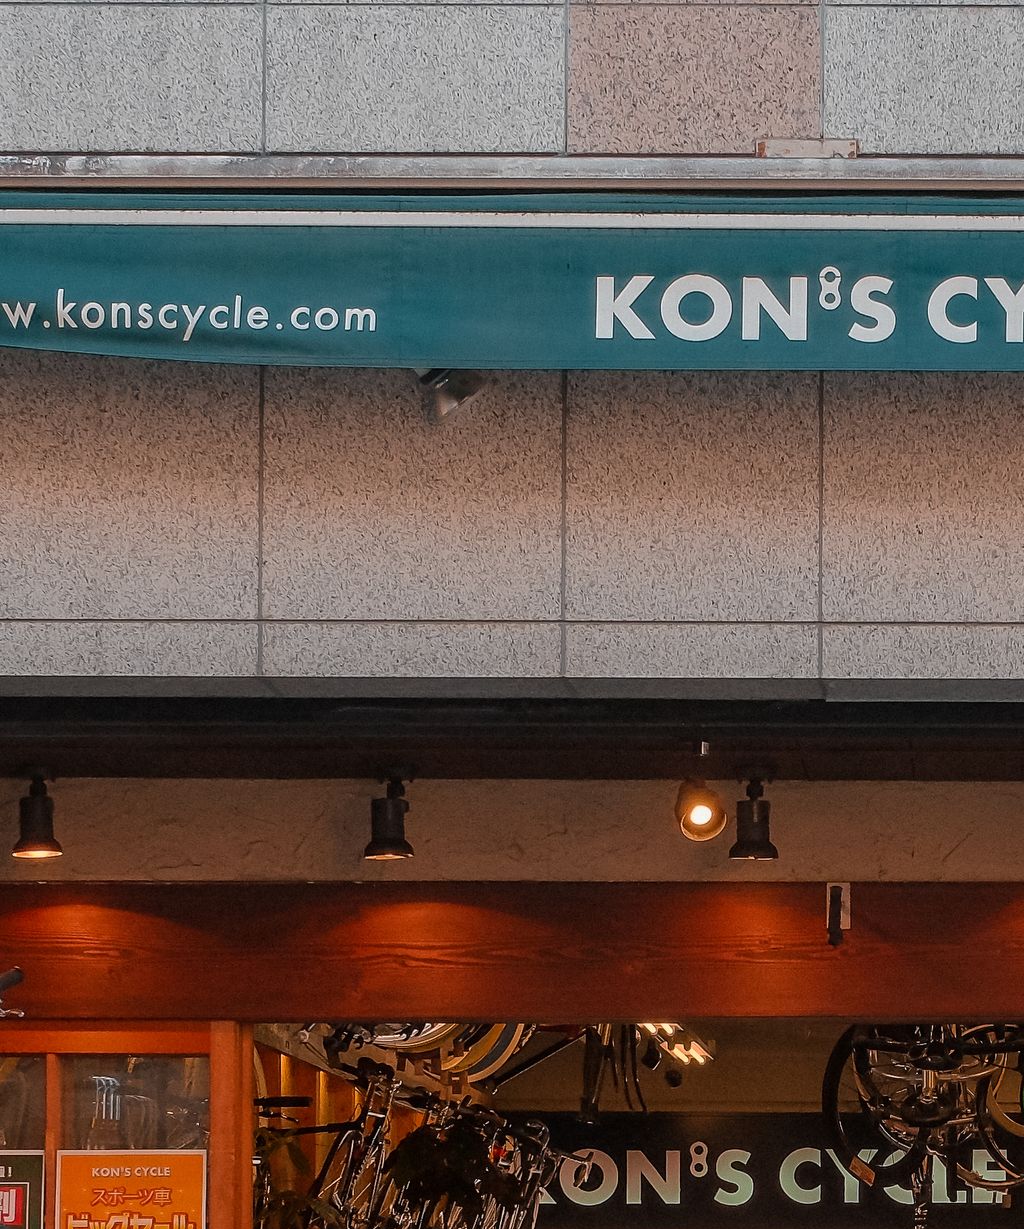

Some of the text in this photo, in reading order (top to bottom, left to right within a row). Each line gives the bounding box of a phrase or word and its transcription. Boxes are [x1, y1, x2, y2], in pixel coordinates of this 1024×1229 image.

[91, 1167, 171, 1177] KON'S CYCLE
[539, 1141, 754, 1206] ON'S
[91, 1187, 171, 1206] スポーツ車
